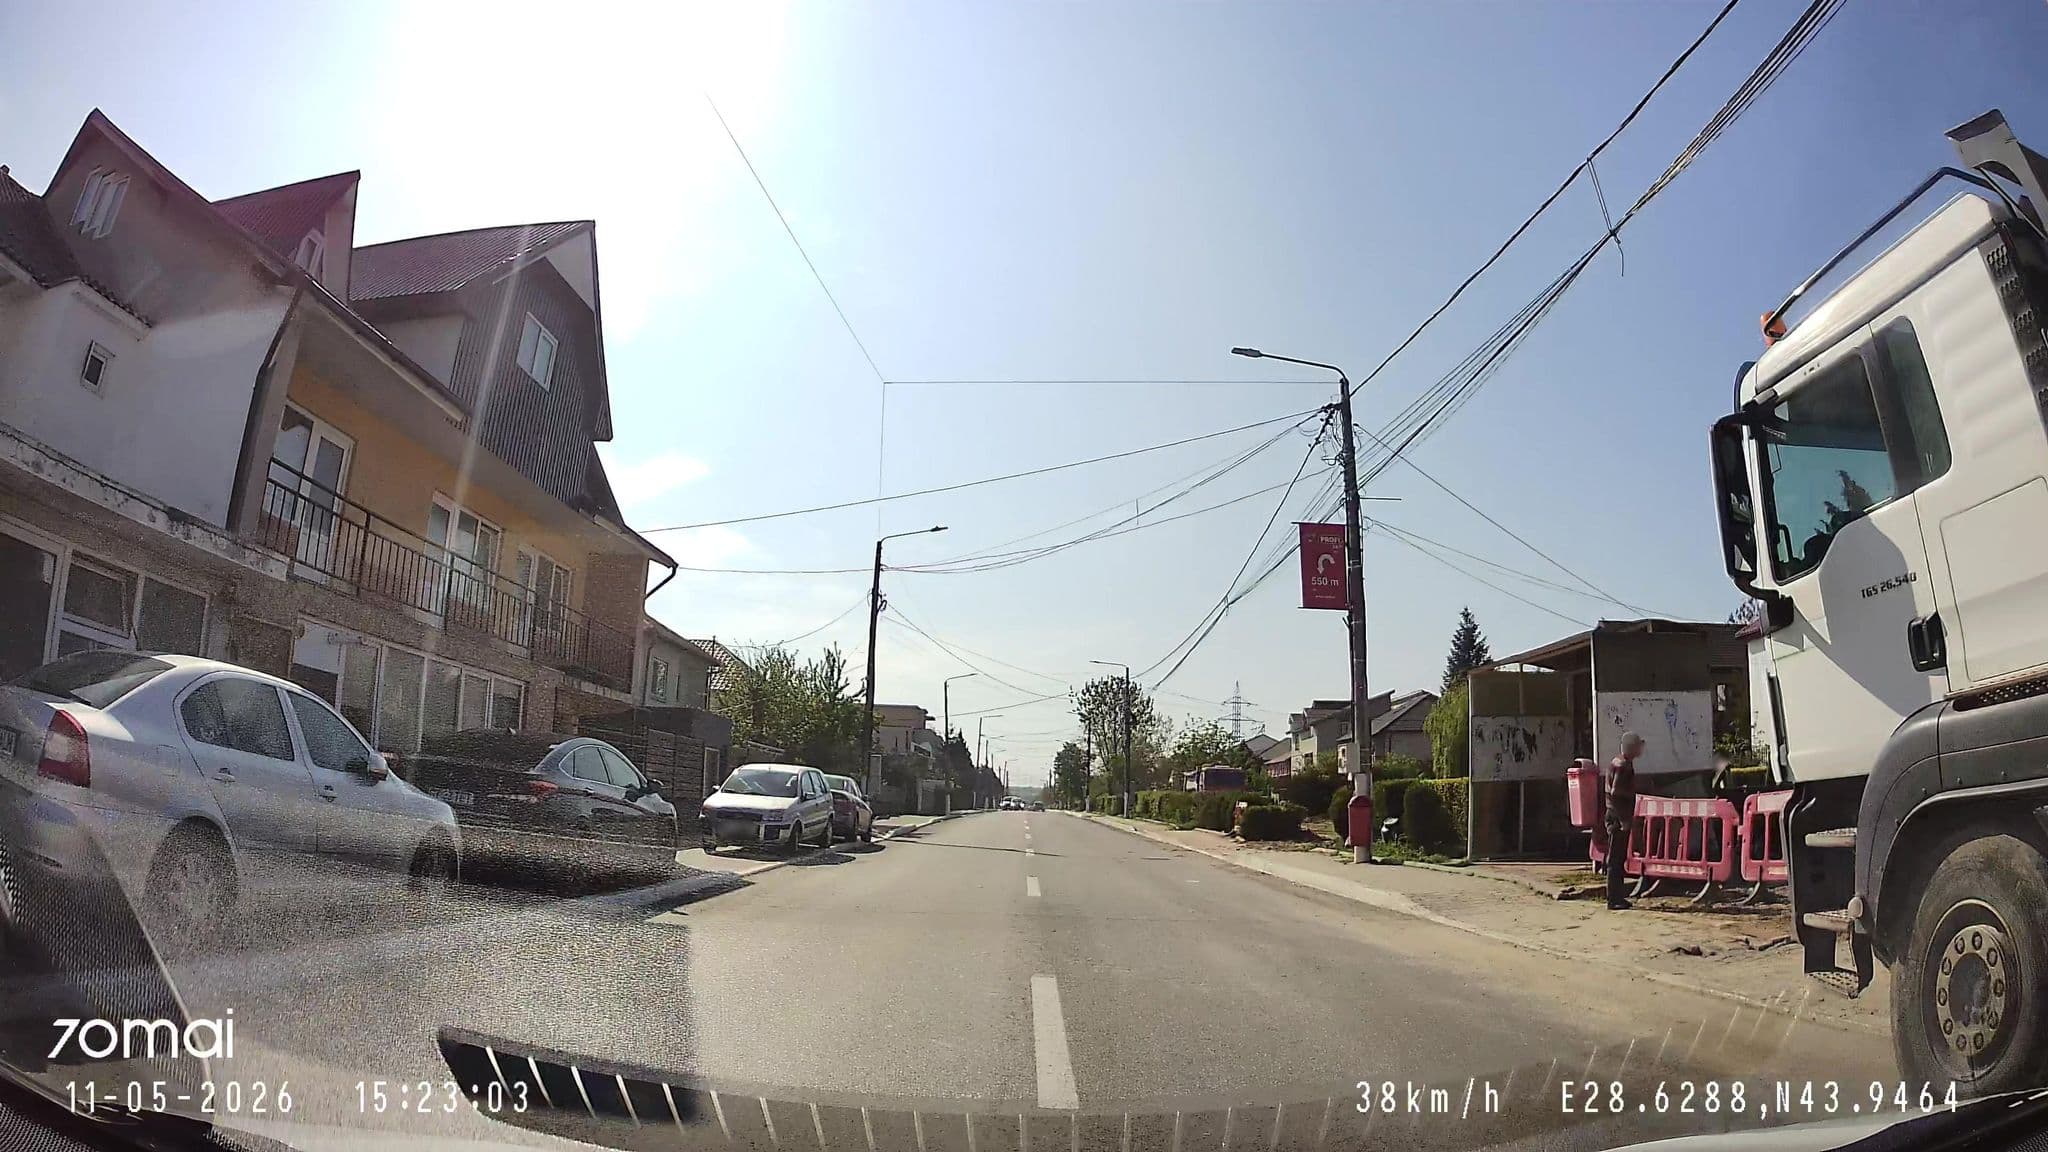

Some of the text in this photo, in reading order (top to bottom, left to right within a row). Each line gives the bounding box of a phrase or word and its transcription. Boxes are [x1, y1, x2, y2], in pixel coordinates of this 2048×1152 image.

[1311, 576, 1328, 586] 550
[1861, 572, 1917, 598] TGS 26.540
